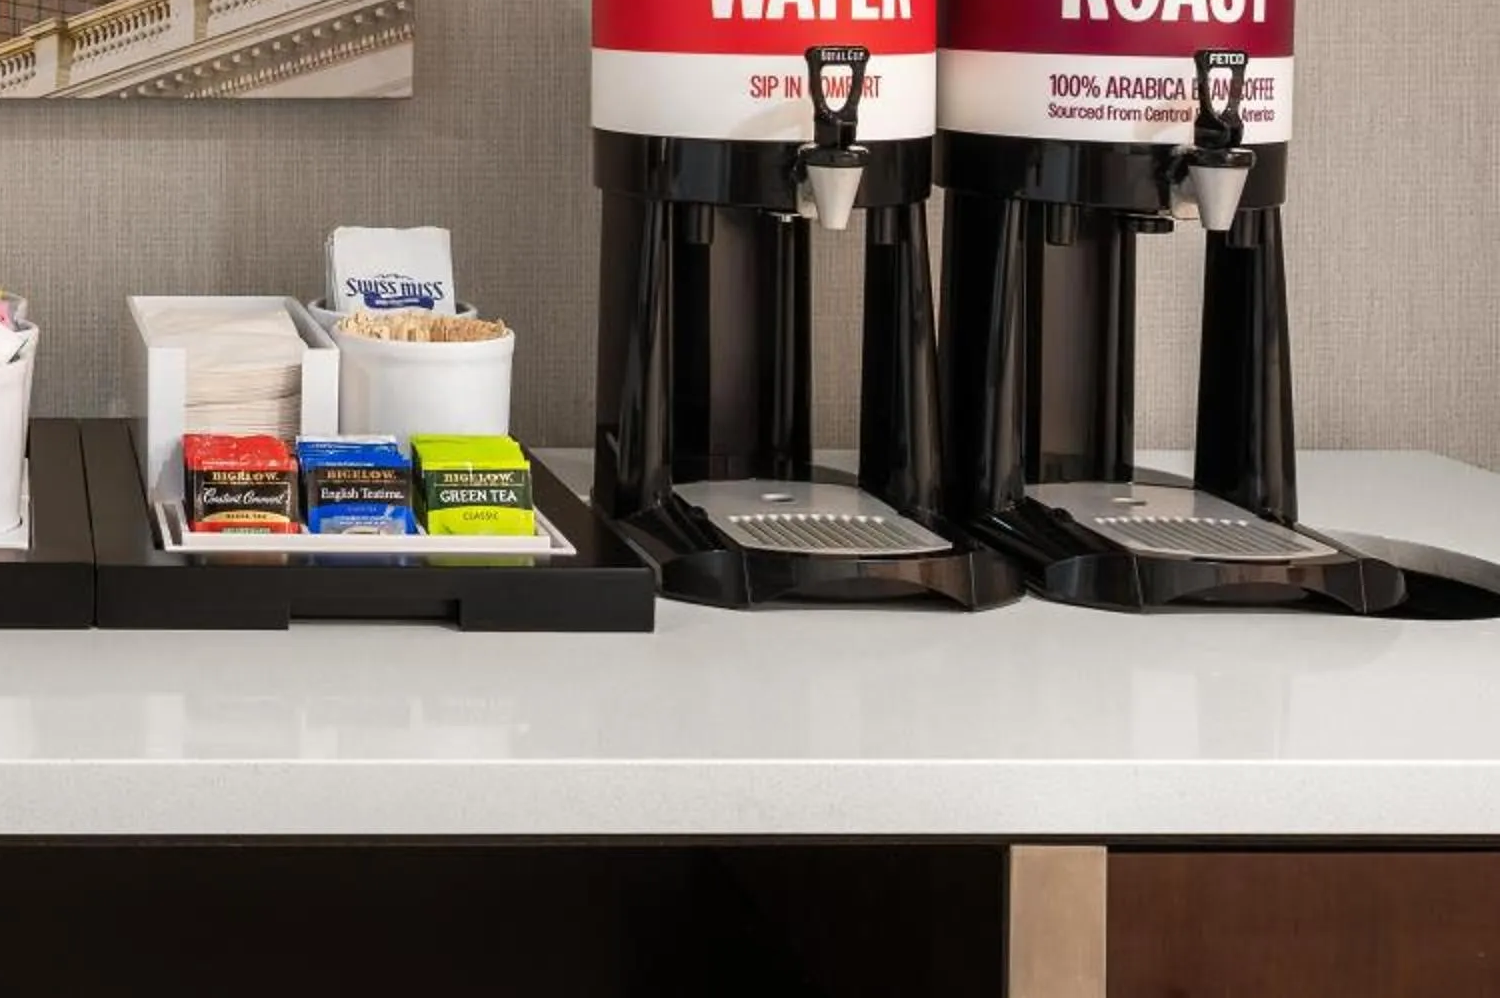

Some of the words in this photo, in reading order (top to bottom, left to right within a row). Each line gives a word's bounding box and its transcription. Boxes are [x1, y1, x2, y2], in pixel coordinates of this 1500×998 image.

[1209, 53, 1245, 65] FETCO
[750, 75, 779, 99] SIP
[785, 75, 801, 99] IN
[811, 74, 883, 99] OMFRT
[1049, 74, 1100, 97] 100%
[1105, 77, 1186, 100] ARABICA
[1239, 77, 1275, 101] OFFEE
[1048, 102, 1104, 120] Sourced
[1144, 106, 1193, 123] Central
[321, 487, 359, 502] English
[439, 490, 487, 503] GREEN
[489, 490, 517, 503] TEA
[462, 511, 498, 521] CLASSIC
